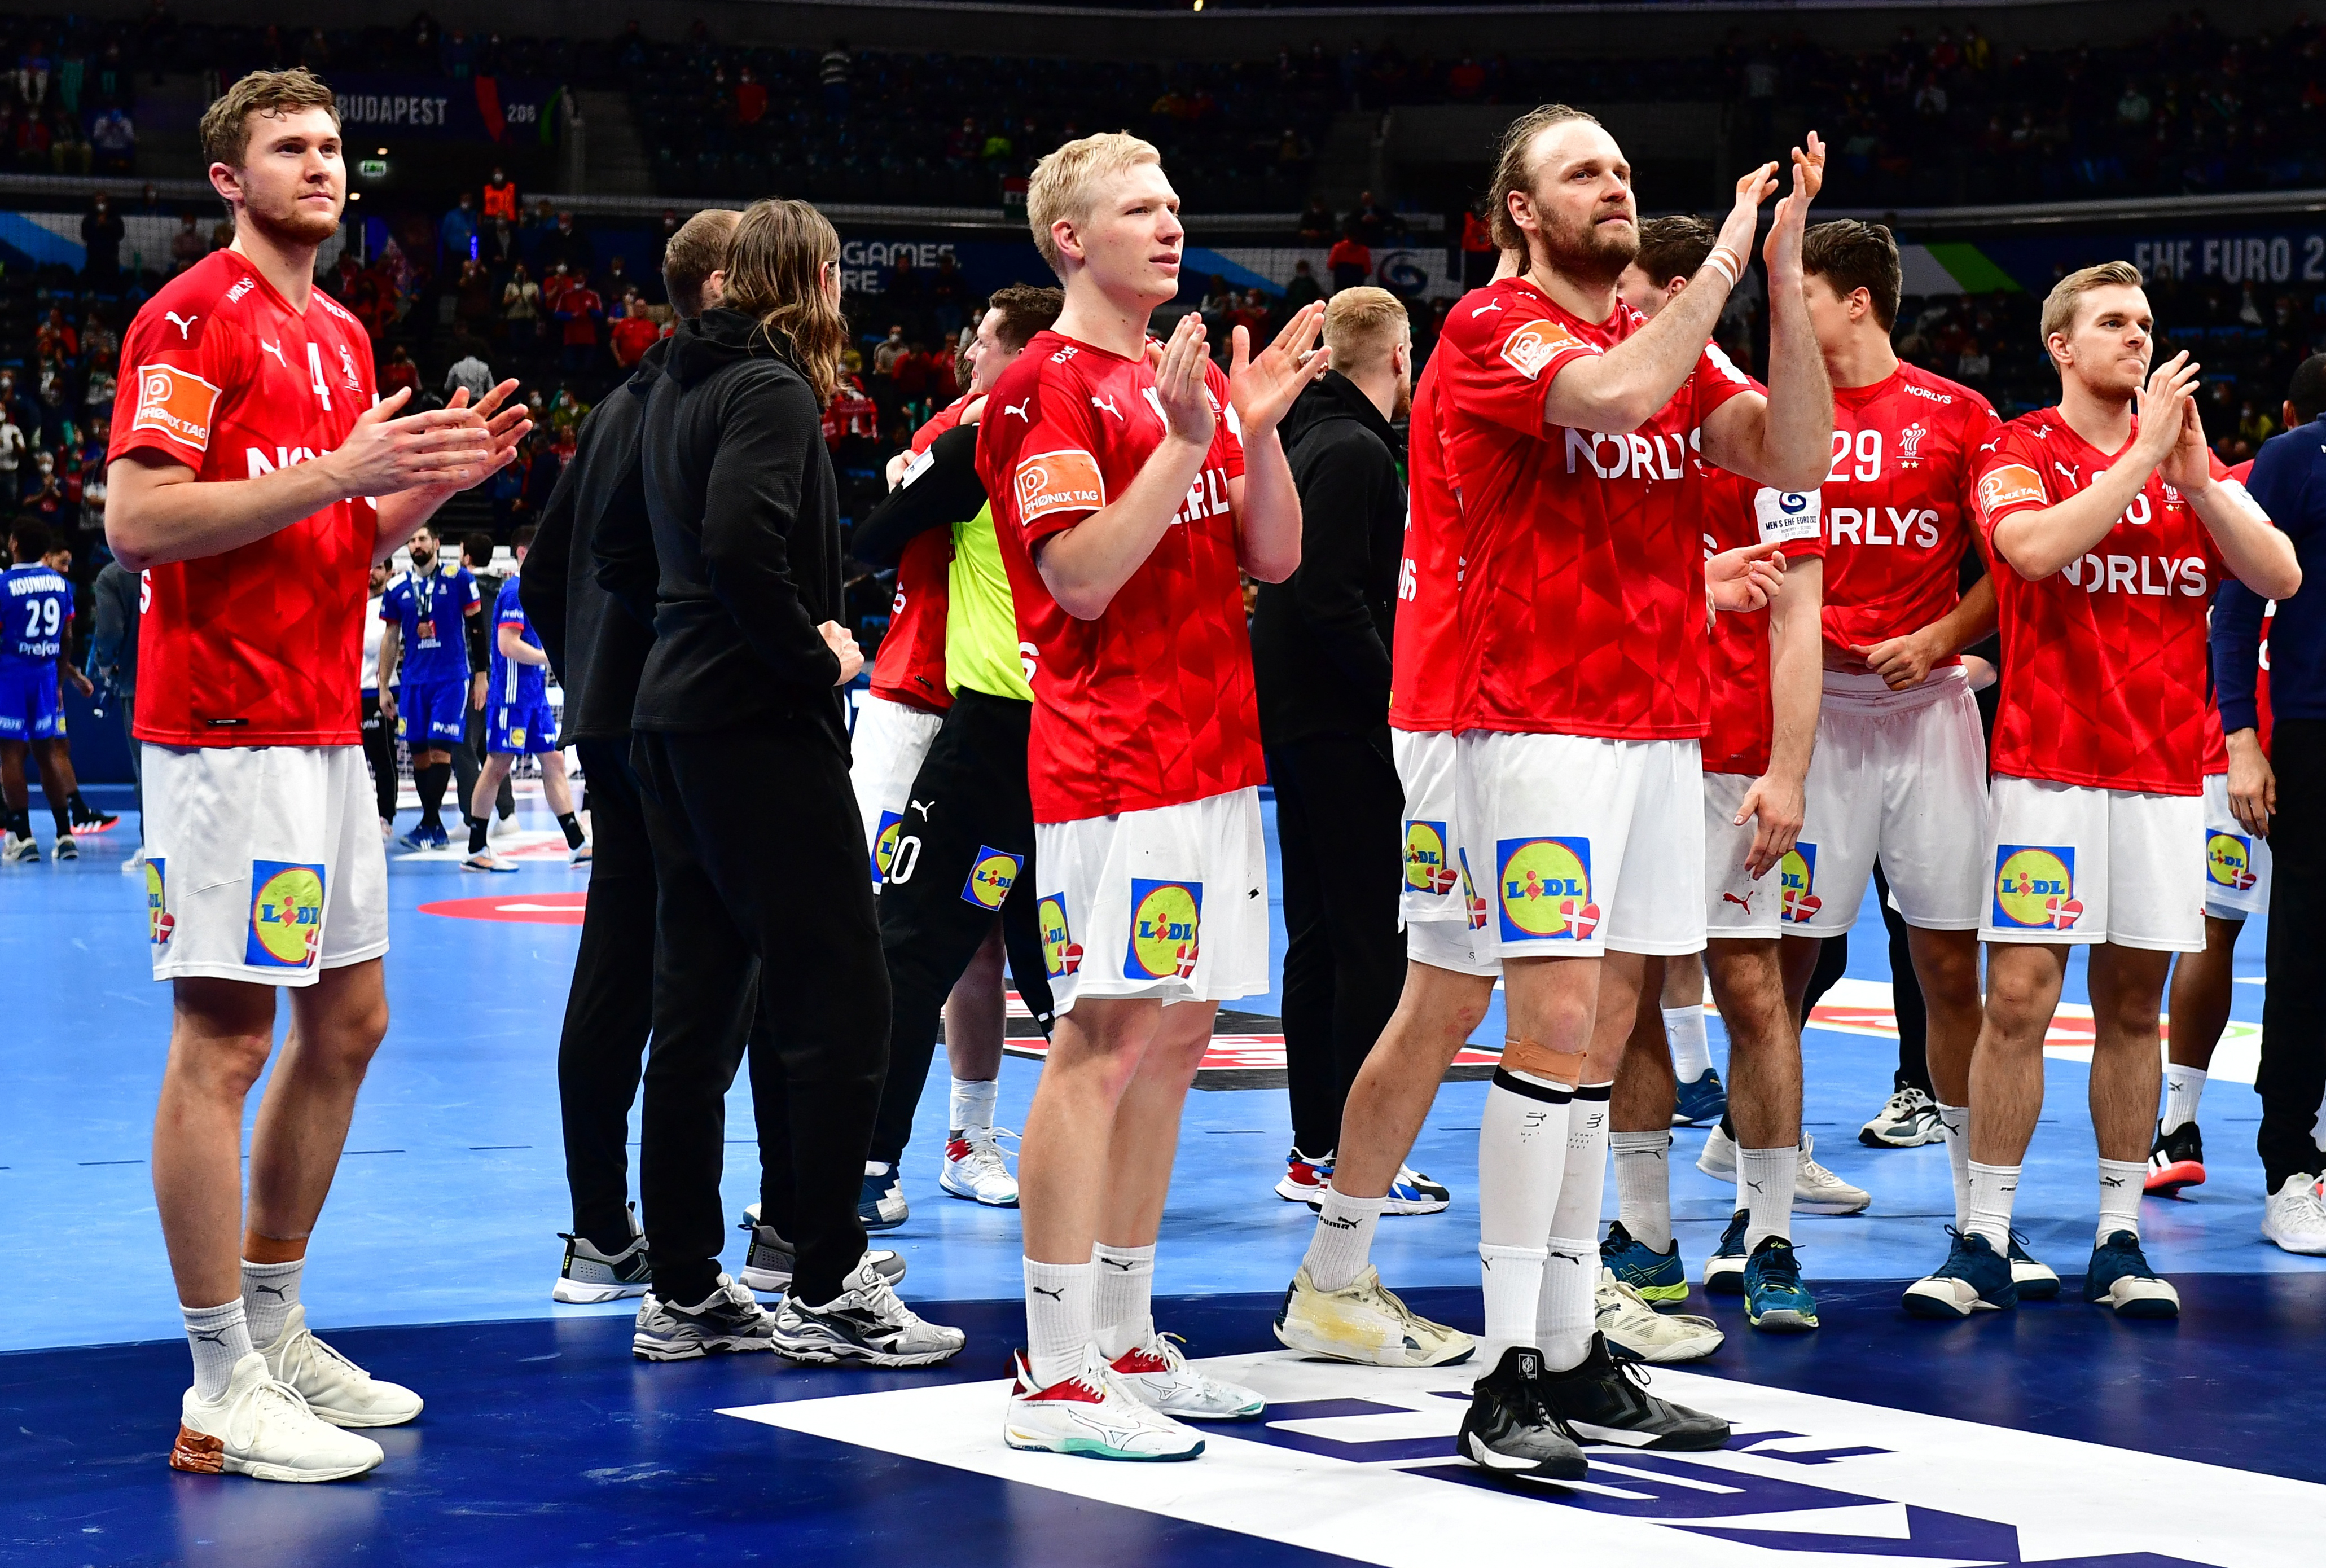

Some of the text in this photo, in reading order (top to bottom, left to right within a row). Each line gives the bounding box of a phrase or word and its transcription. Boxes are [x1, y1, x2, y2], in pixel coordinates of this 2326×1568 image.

[336, 94, 447, 125] BUDAPEST
[306, 342, 331, 411] 4
[1903, 384, 1952, 405] NORLYS
[182, 420, 206, 440] TAG
[1825, 429, 1883, 482] 29
[1073, 489, 1099, 502] TAG
[1784, 517, 1795, 527] EHF
[1796, 516, 1810, 525] EURO
[25, 597, 60, 638] 29
